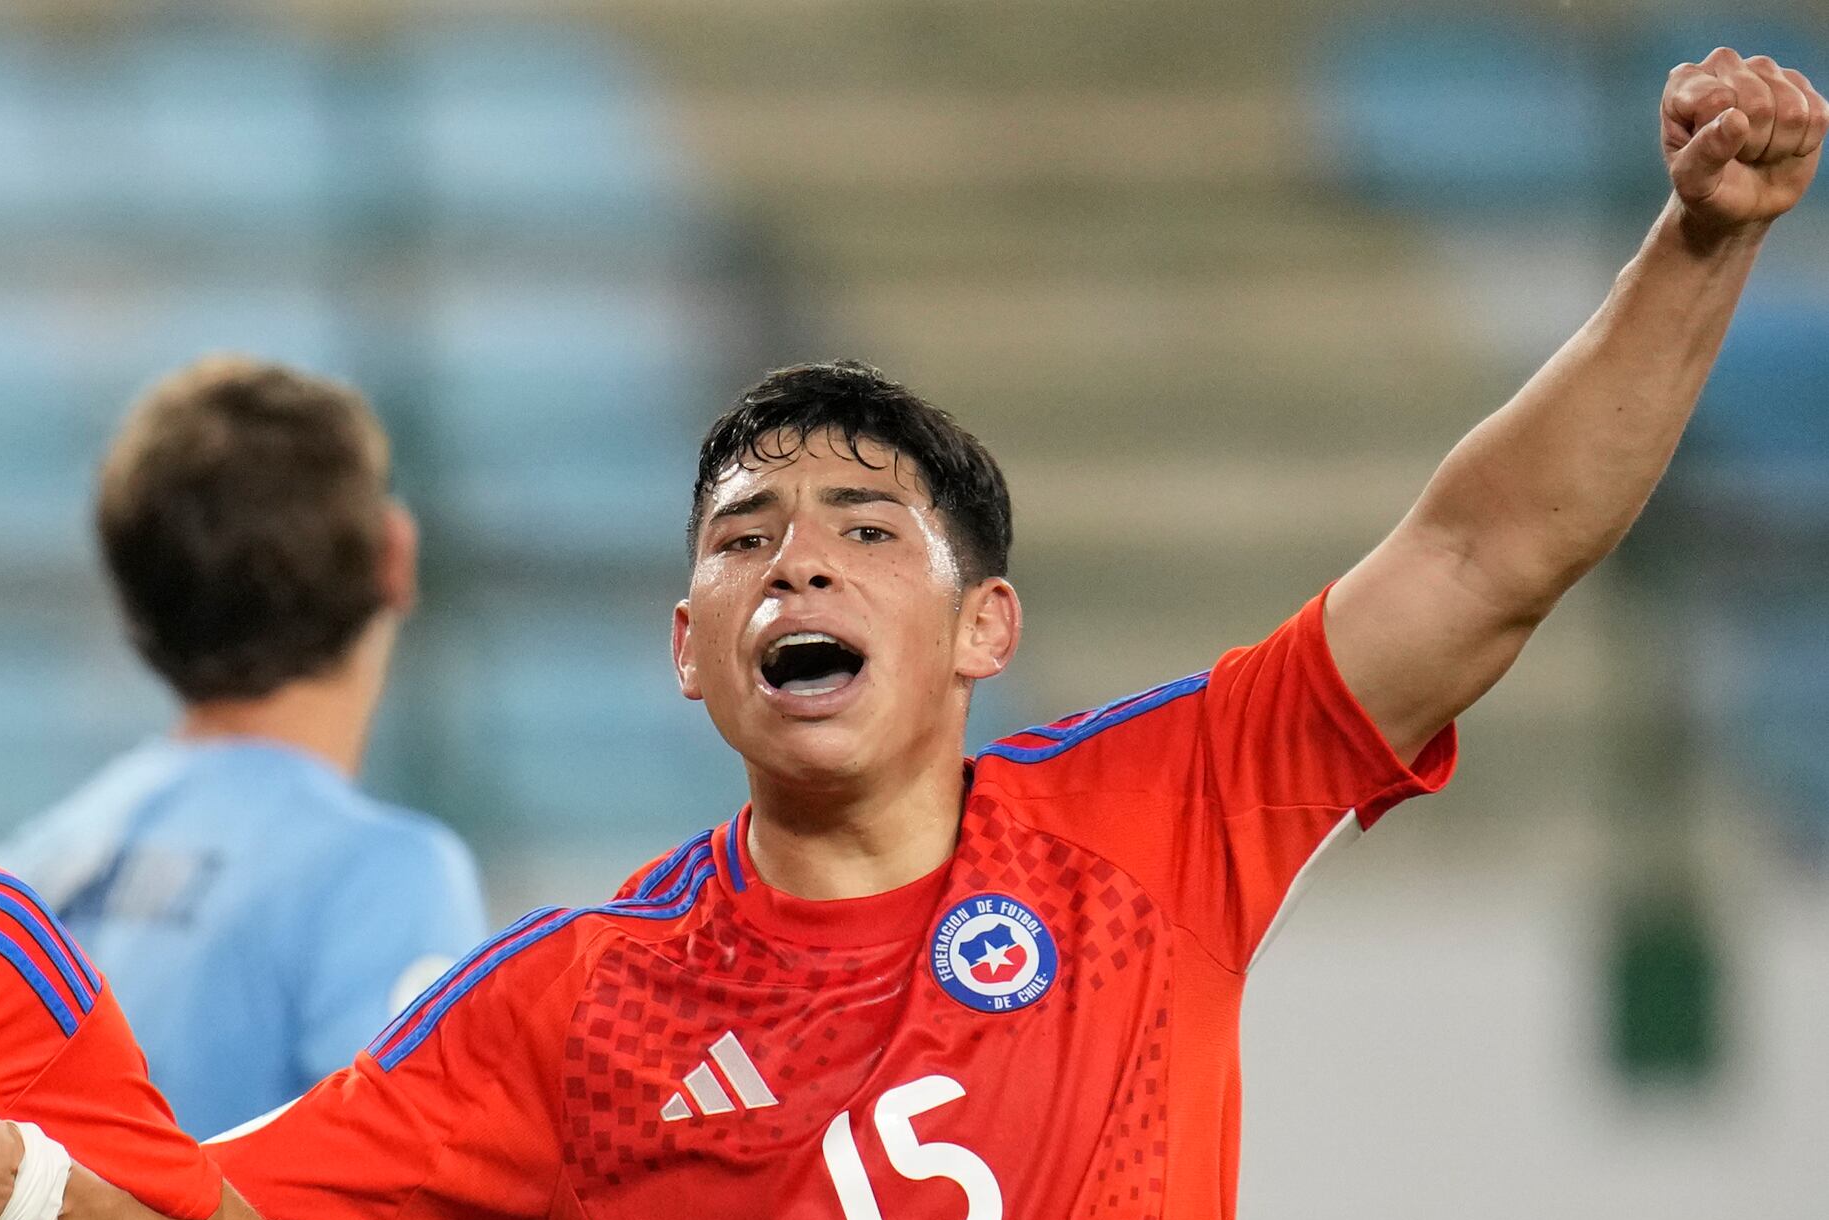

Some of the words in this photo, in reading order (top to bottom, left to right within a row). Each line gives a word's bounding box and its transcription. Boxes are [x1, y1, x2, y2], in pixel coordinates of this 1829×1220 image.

[935, 907, 971, 982] FEDERACION
[976, 899, 993, 914] DE
[999, 901, 1043, 938] FUTBOL
[994, 995, 1012, 1010] DE
[1017, 974, 1049, 1003] CHILE
